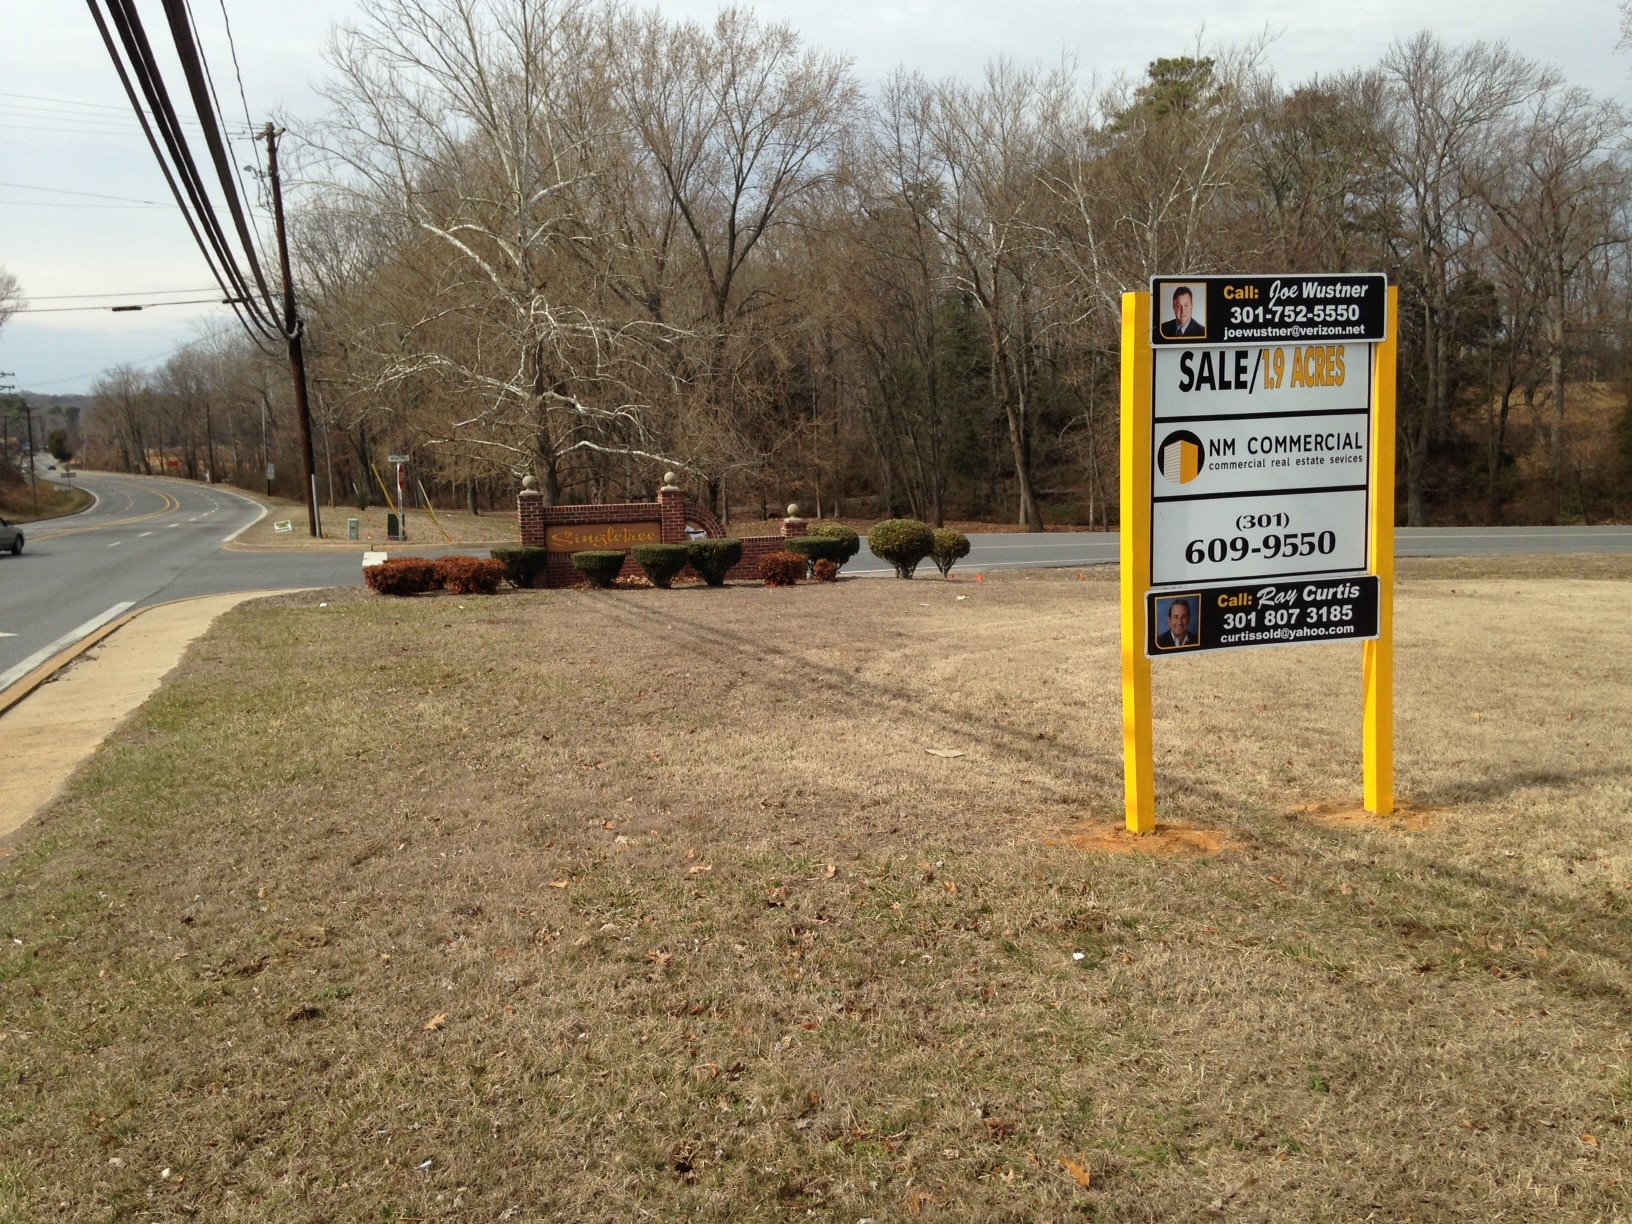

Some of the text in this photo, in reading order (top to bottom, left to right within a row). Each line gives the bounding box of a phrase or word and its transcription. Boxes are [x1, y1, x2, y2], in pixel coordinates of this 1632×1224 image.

[1223, 280, 1368, 309] Call: Joe Wustner
[1230, 304, 1360, 324] 301-752-5550
[1223, 324, 1365, 340] joewustner@verizon.net
[1290, 344, 1346, 388] ACRES
[1209, 432, 1363, 457] NM COMMERCIAL
[1208, 454, 1363, 471] commercial real estate sevices
[1235, 512, 1290, 531] (301)
[1185, 530, 1337, 565] 609-9550
[1217, 582, 1360, 610] Call: Ray Curtis
[1223, 605, 1353, 629] 301 807 3185
[1220, 624, 1355, 643] curtissold@yahoo.com
